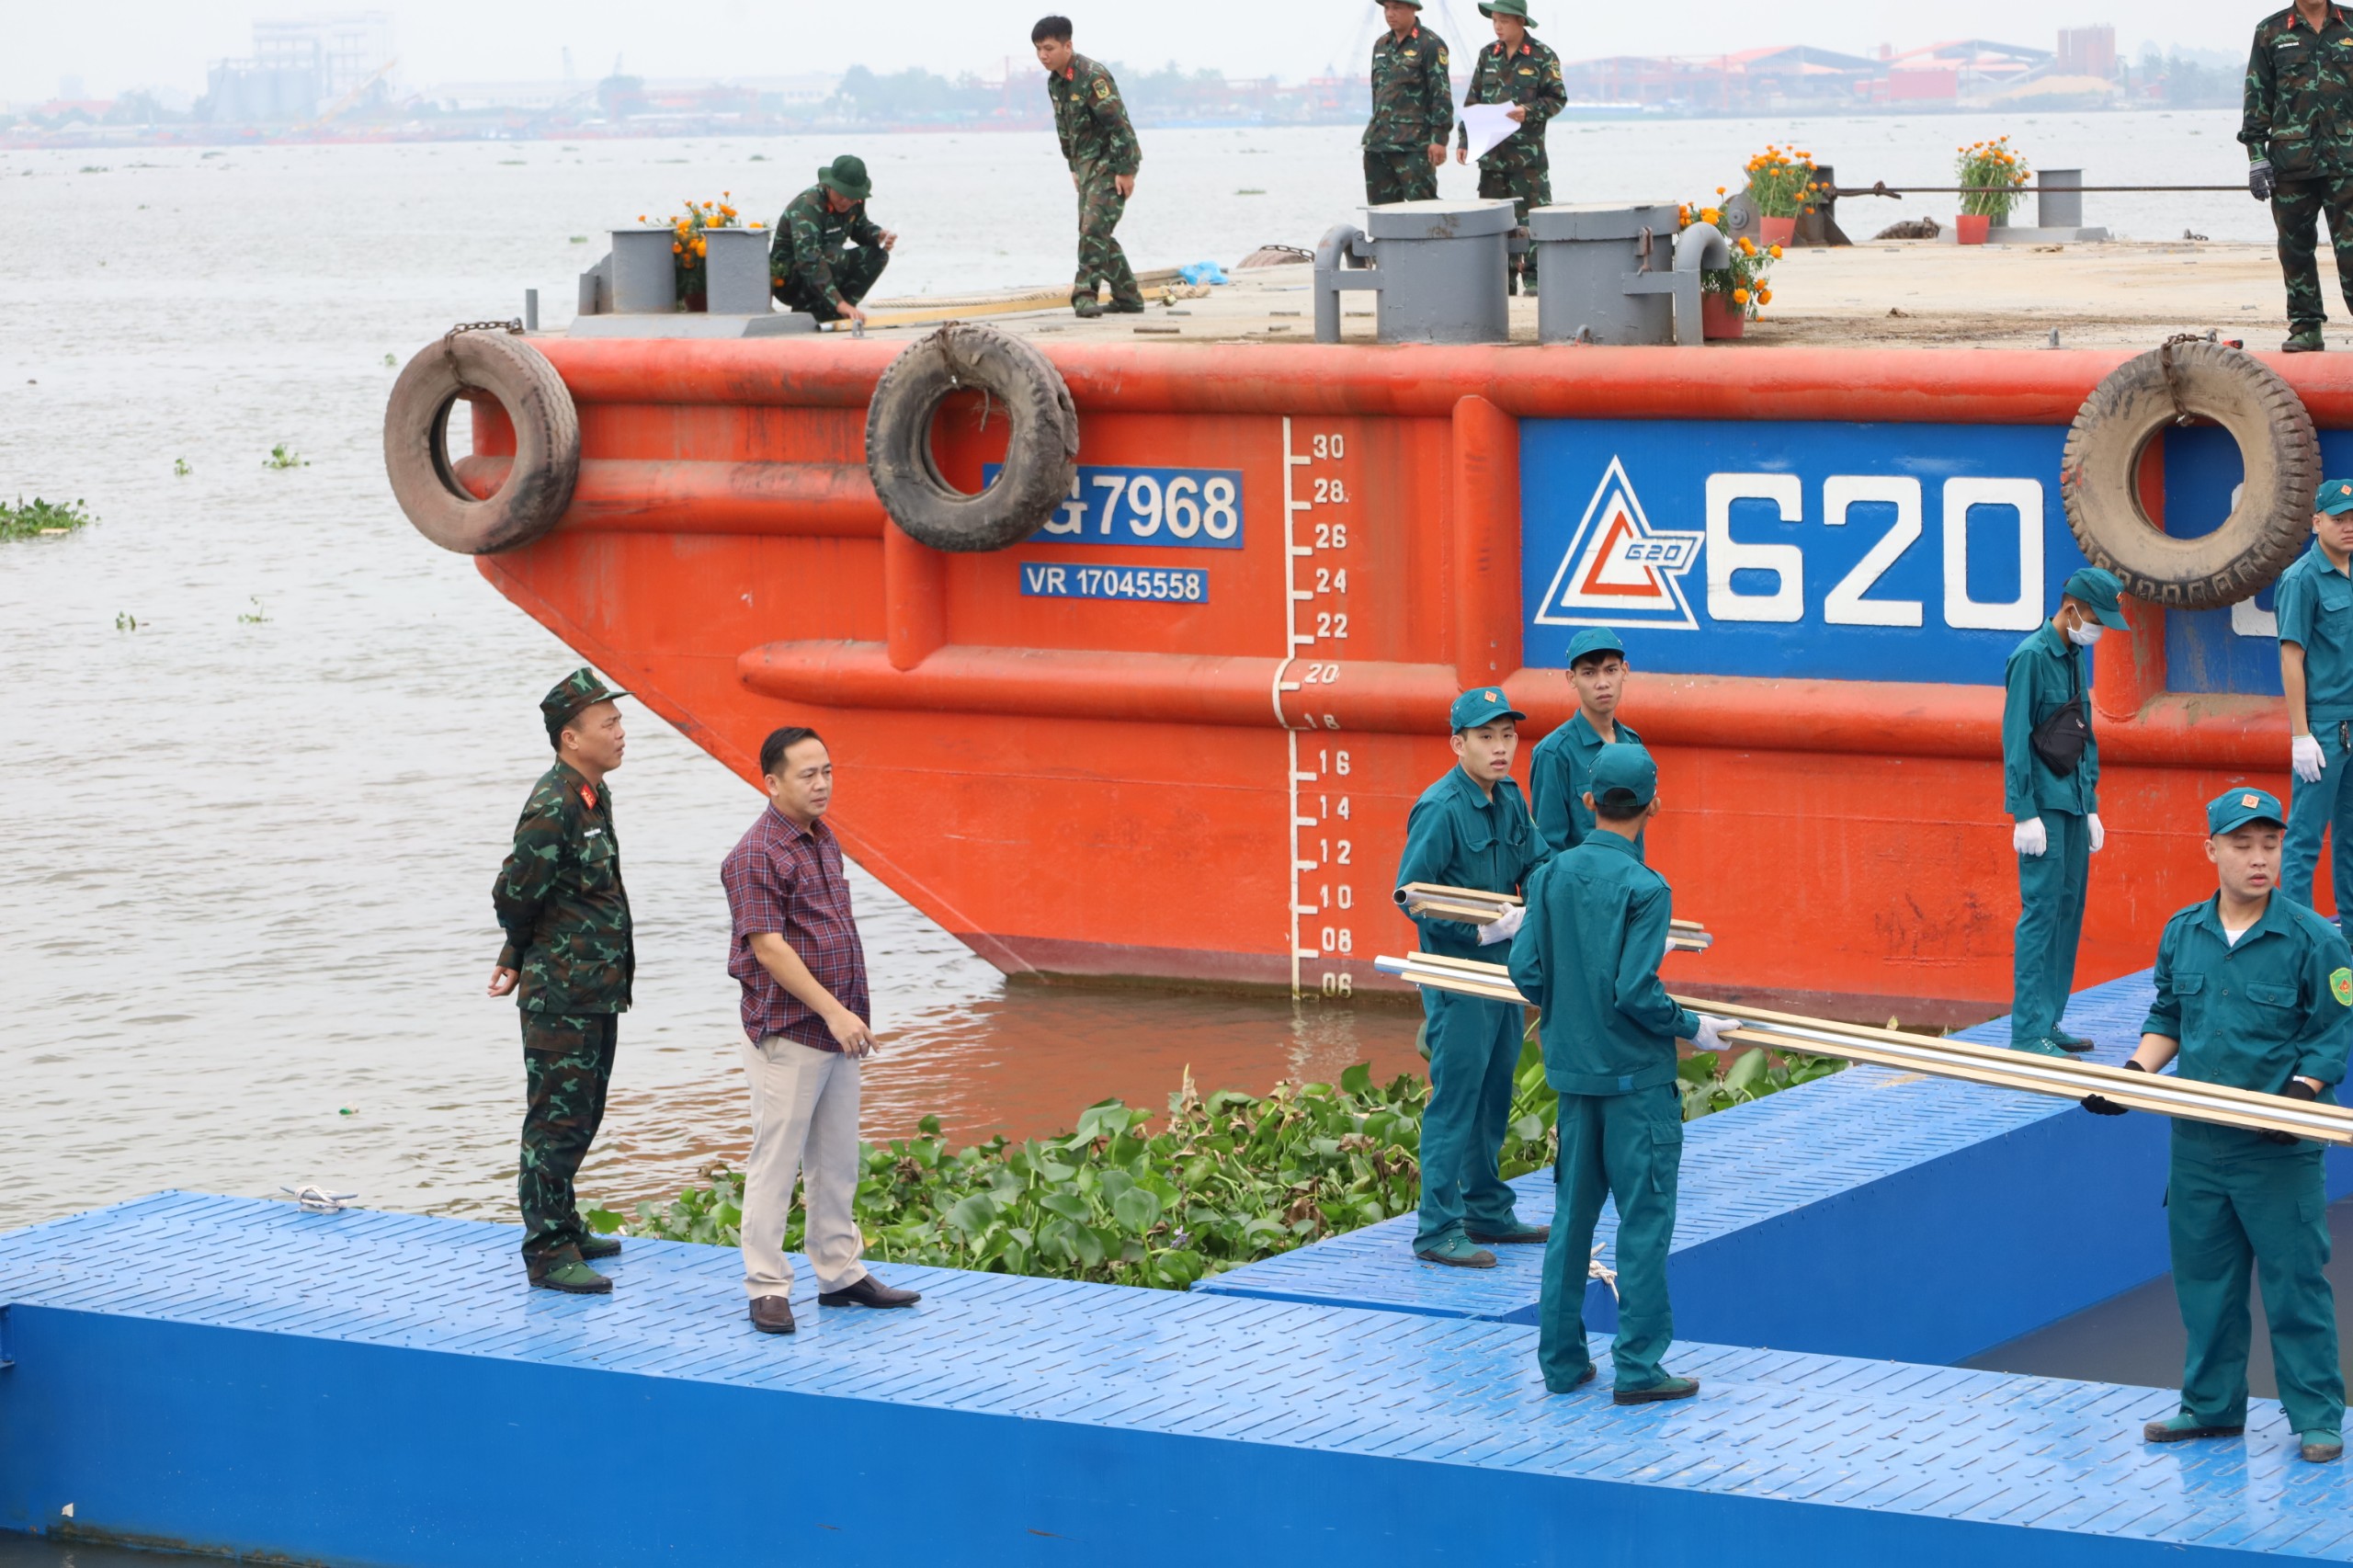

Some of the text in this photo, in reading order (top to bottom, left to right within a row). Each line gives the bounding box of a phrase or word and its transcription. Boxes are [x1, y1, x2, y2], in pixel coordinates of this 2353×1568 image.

[1313, 434, 1344, 459] 30
[1313, 478, 1345, 504] 28
[1314, 523, 1347, 549] 26
[1706, 472, 2044, 631] 620
[1027, 567, 1200, 600] VR 17045558
[1315, 568, 1347, 594] 24
[1316, 612, 1347, 639] 22
[1304, 663, 1340, 684] 20
[1320, 749, 1350, 776] 16
[1320, 795, 1349, 820] 14
[1320, 838, 1351, 865] 12
[1320, 884, 1352, 910] 10
[1322, 926, 1352, 953] 08
[1322, 971, 1352, 998] 06
